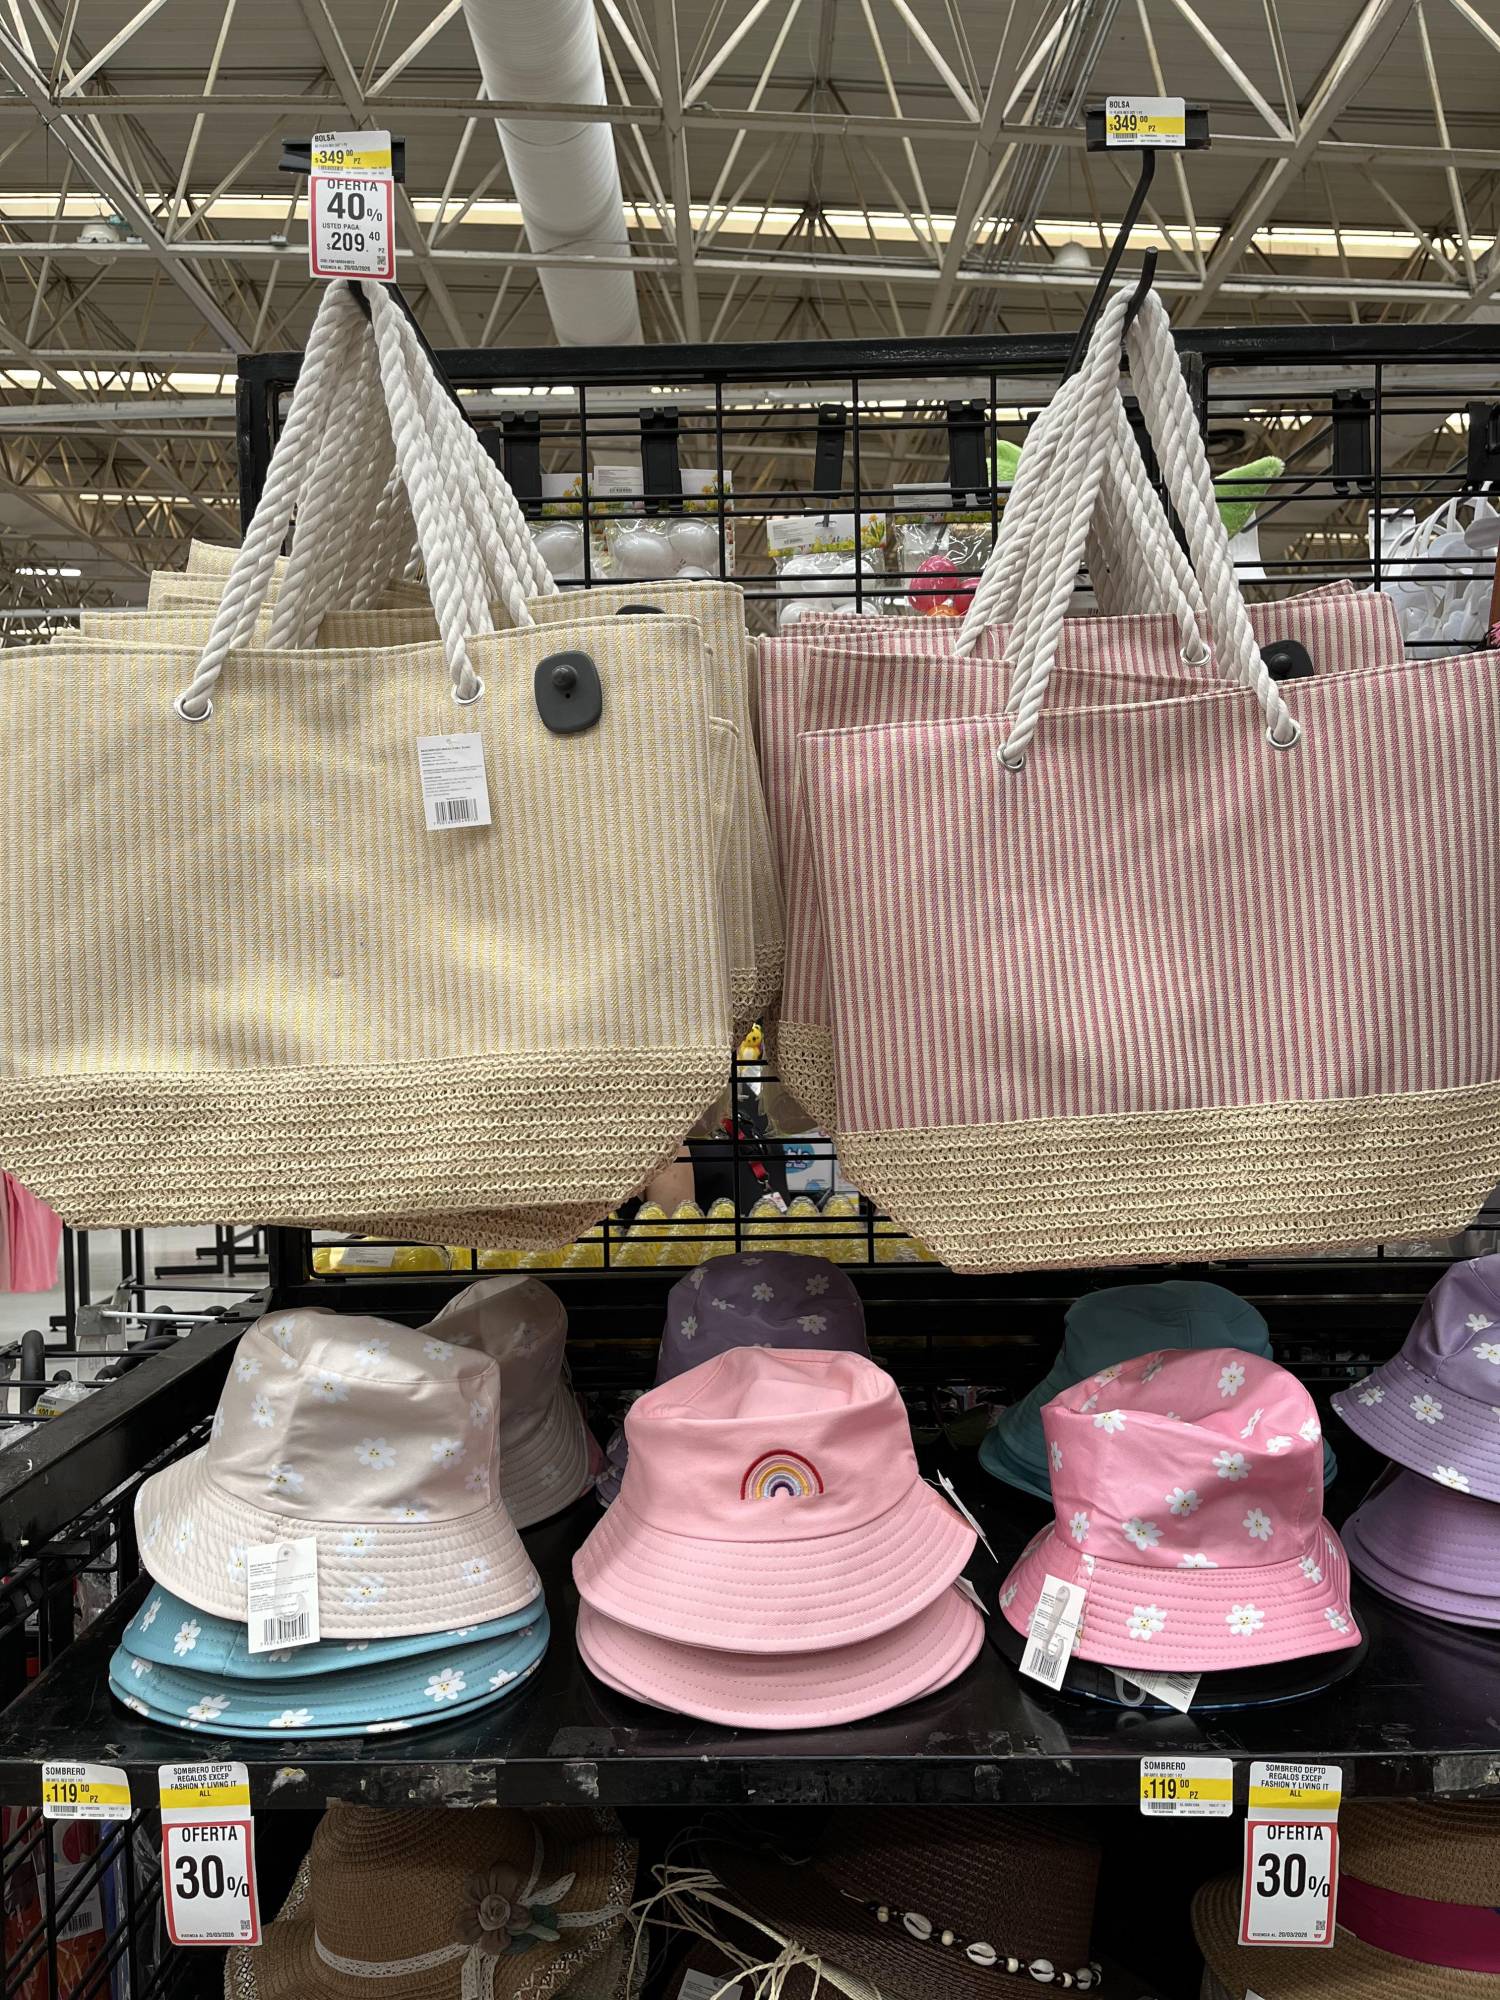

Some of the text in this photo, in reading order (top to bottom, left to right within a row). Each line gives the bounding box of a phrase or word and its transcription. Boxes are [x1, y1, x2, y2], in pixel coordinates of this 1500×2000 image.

[314, 134, 335, 142] BOLSA
[327, 178, 378, 192] OFERTA
[327, 192, 383, 222] 40%
[173, 1764, 232, 1775] SOMBRERO DEPTO
[1144, 1761, 1186, 1771] SOMBRERO
[1265, 1764, 1326, 1775] SOMBRERO DEPTO
[45, 1767, 86, 1776] SOMBRERO
[177, 1773, 229, 1782] REGALOS EXCEP
[1268, 1772, 1323, 1782] REGALOS EXCEP
[170, 1782, 199, 1790] FASHION
[1261, 1780, 1290, 1788] FASHION
[1298, 1782, 1321, 1790] LIVING
[1189, 1791, 1199, 1800] PZ
[1289, 1789, 1302, 1797] ALL
[89, 1795, 99, 1803] PZ
[181, 1825, 238, 1842] OFERTA
[1267, 1825, 1323, 1841] OFERTA
[175, 1854, 250, 1900] 30%
[1256, 1852, 1330, 1898] 30%
